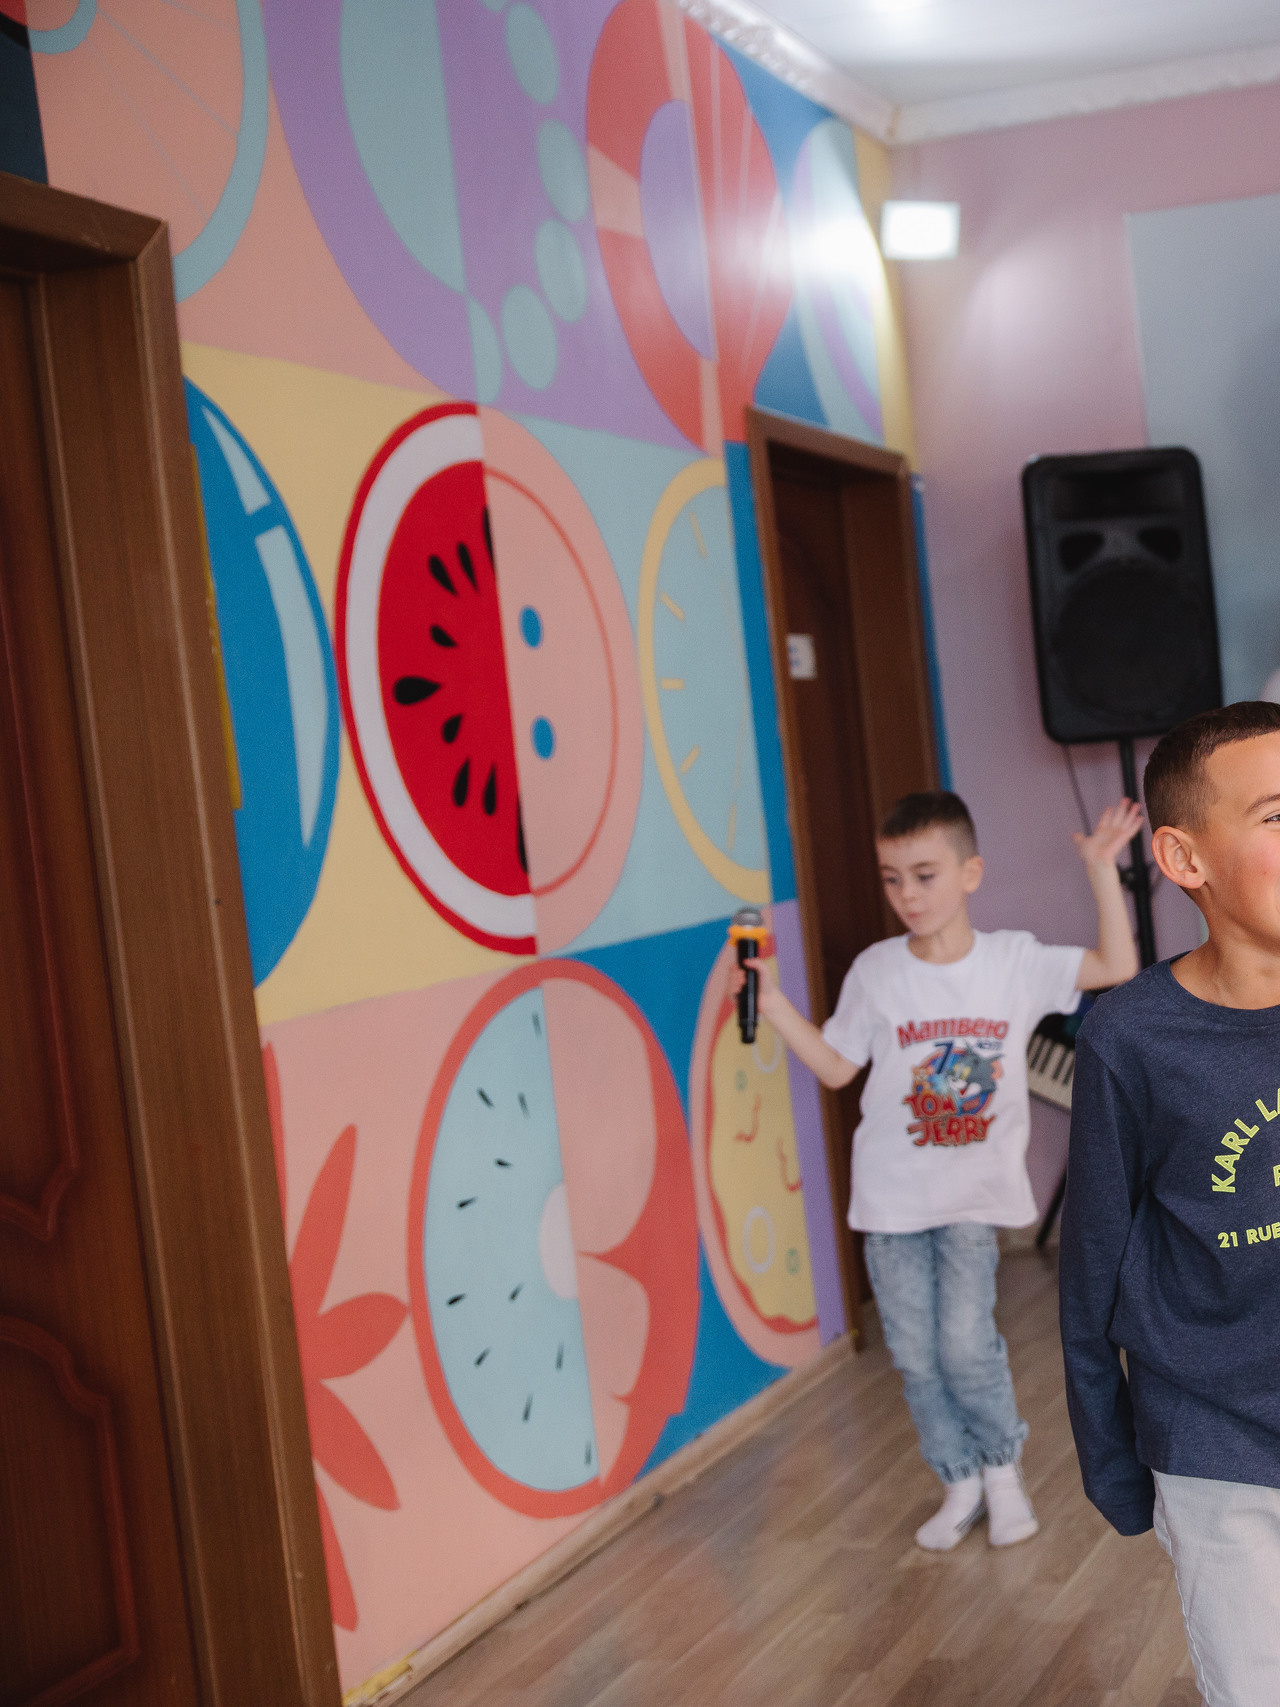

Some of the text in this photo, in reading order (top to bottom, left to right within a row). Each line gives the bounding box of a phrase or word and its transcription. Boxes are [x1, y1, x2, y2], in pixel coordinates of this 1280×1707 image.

[907, 1115, 996, 1146] JERRY
[1211, 1118, 1260, 1193] KARL
[1217, 1232, 1239, 1248] 21
